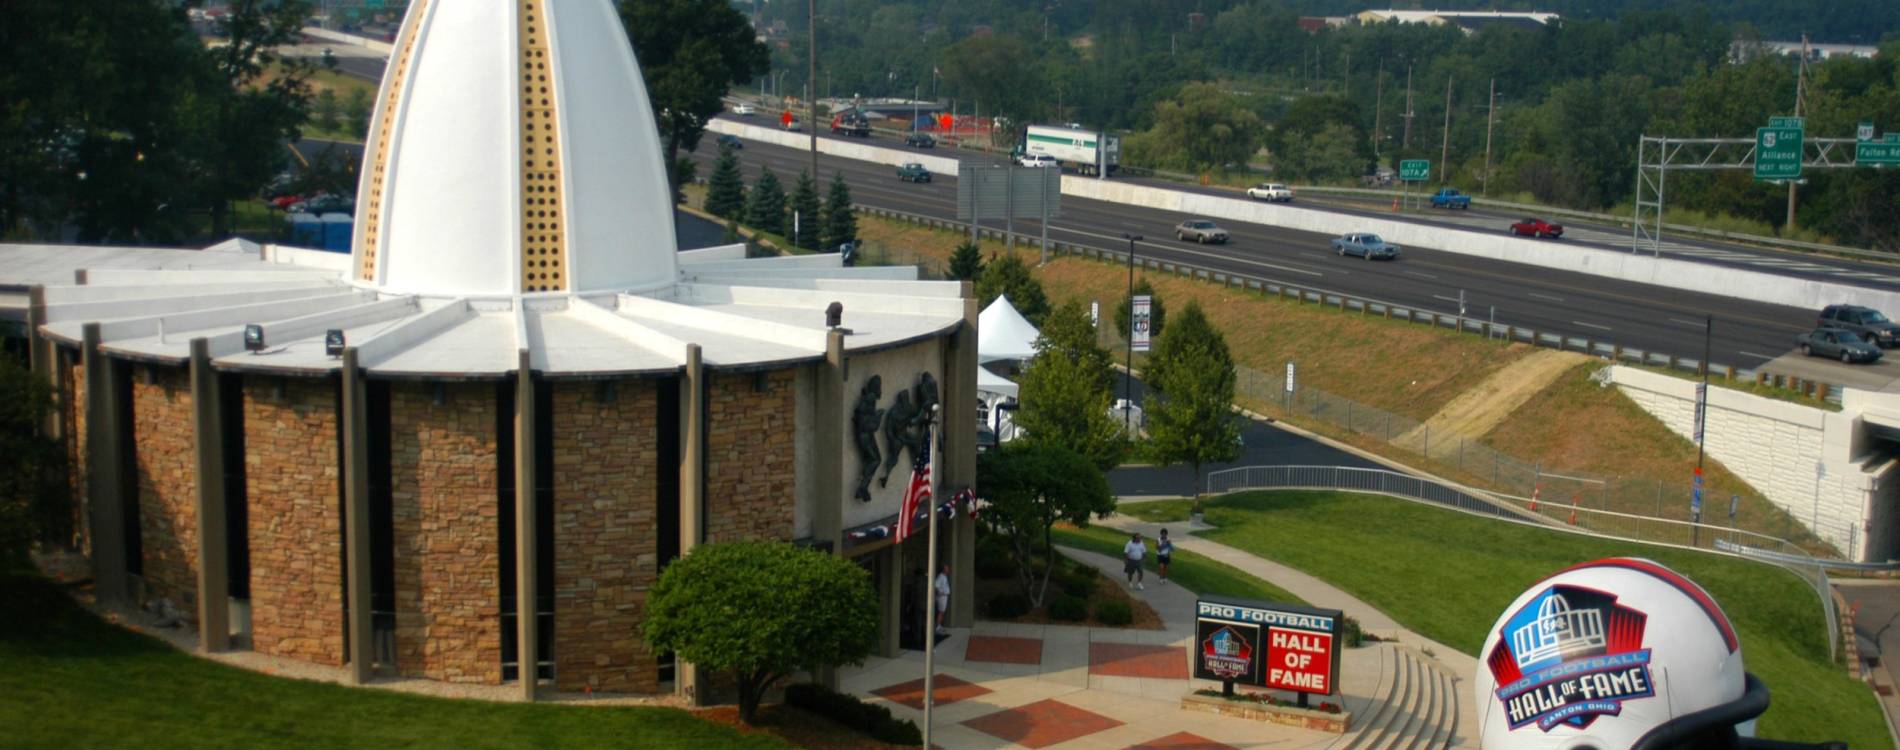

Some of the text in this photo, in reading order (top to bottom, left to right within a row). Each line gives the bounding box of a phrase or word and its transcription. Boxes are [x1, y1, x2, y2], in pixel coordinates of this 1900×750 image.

[1761, 151, 1796, 160] Alliance
[1860, 147, 1886, 157] Fulton
[1200, 605, 1330, 630] PRO FOOTBALL
[1272, 632, 1325, 653] HALL
[1285, 653, 1311, 669] OF
[1270, 669, 1324, 689] FAME
[1501, 653, 1645, 698] PRO FOOTBALL
[1509, 668, 1647, 722] HALL OF FAME
[1543, 702, 1615, 726] CANTON OHIO
